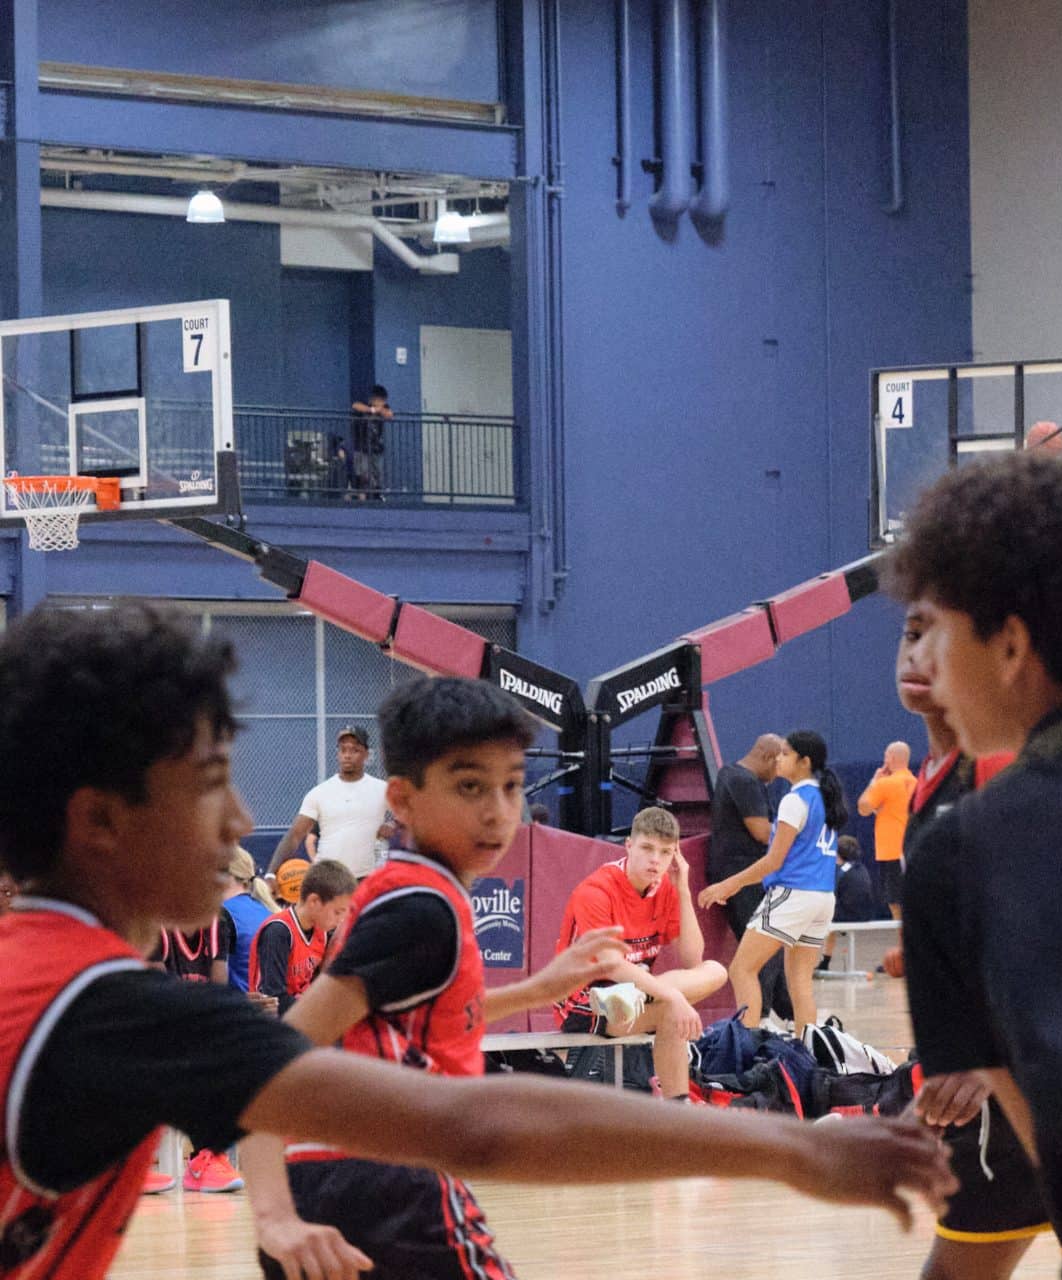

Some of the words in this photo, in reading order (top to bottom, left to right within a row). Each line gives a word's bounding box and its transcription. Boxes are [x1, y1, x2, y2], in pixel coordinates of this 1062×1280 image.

[184, 317, 209, 331] COURT
[190, 333, 204, 367] 7
[885, 381, 911, 393] COURT
[891, 396, 905, 425] 4
[500, 667, 564, 716] SPALDING
[616, 666, 682, 714] SPALDING
[484, 948, 512, 961] Center
